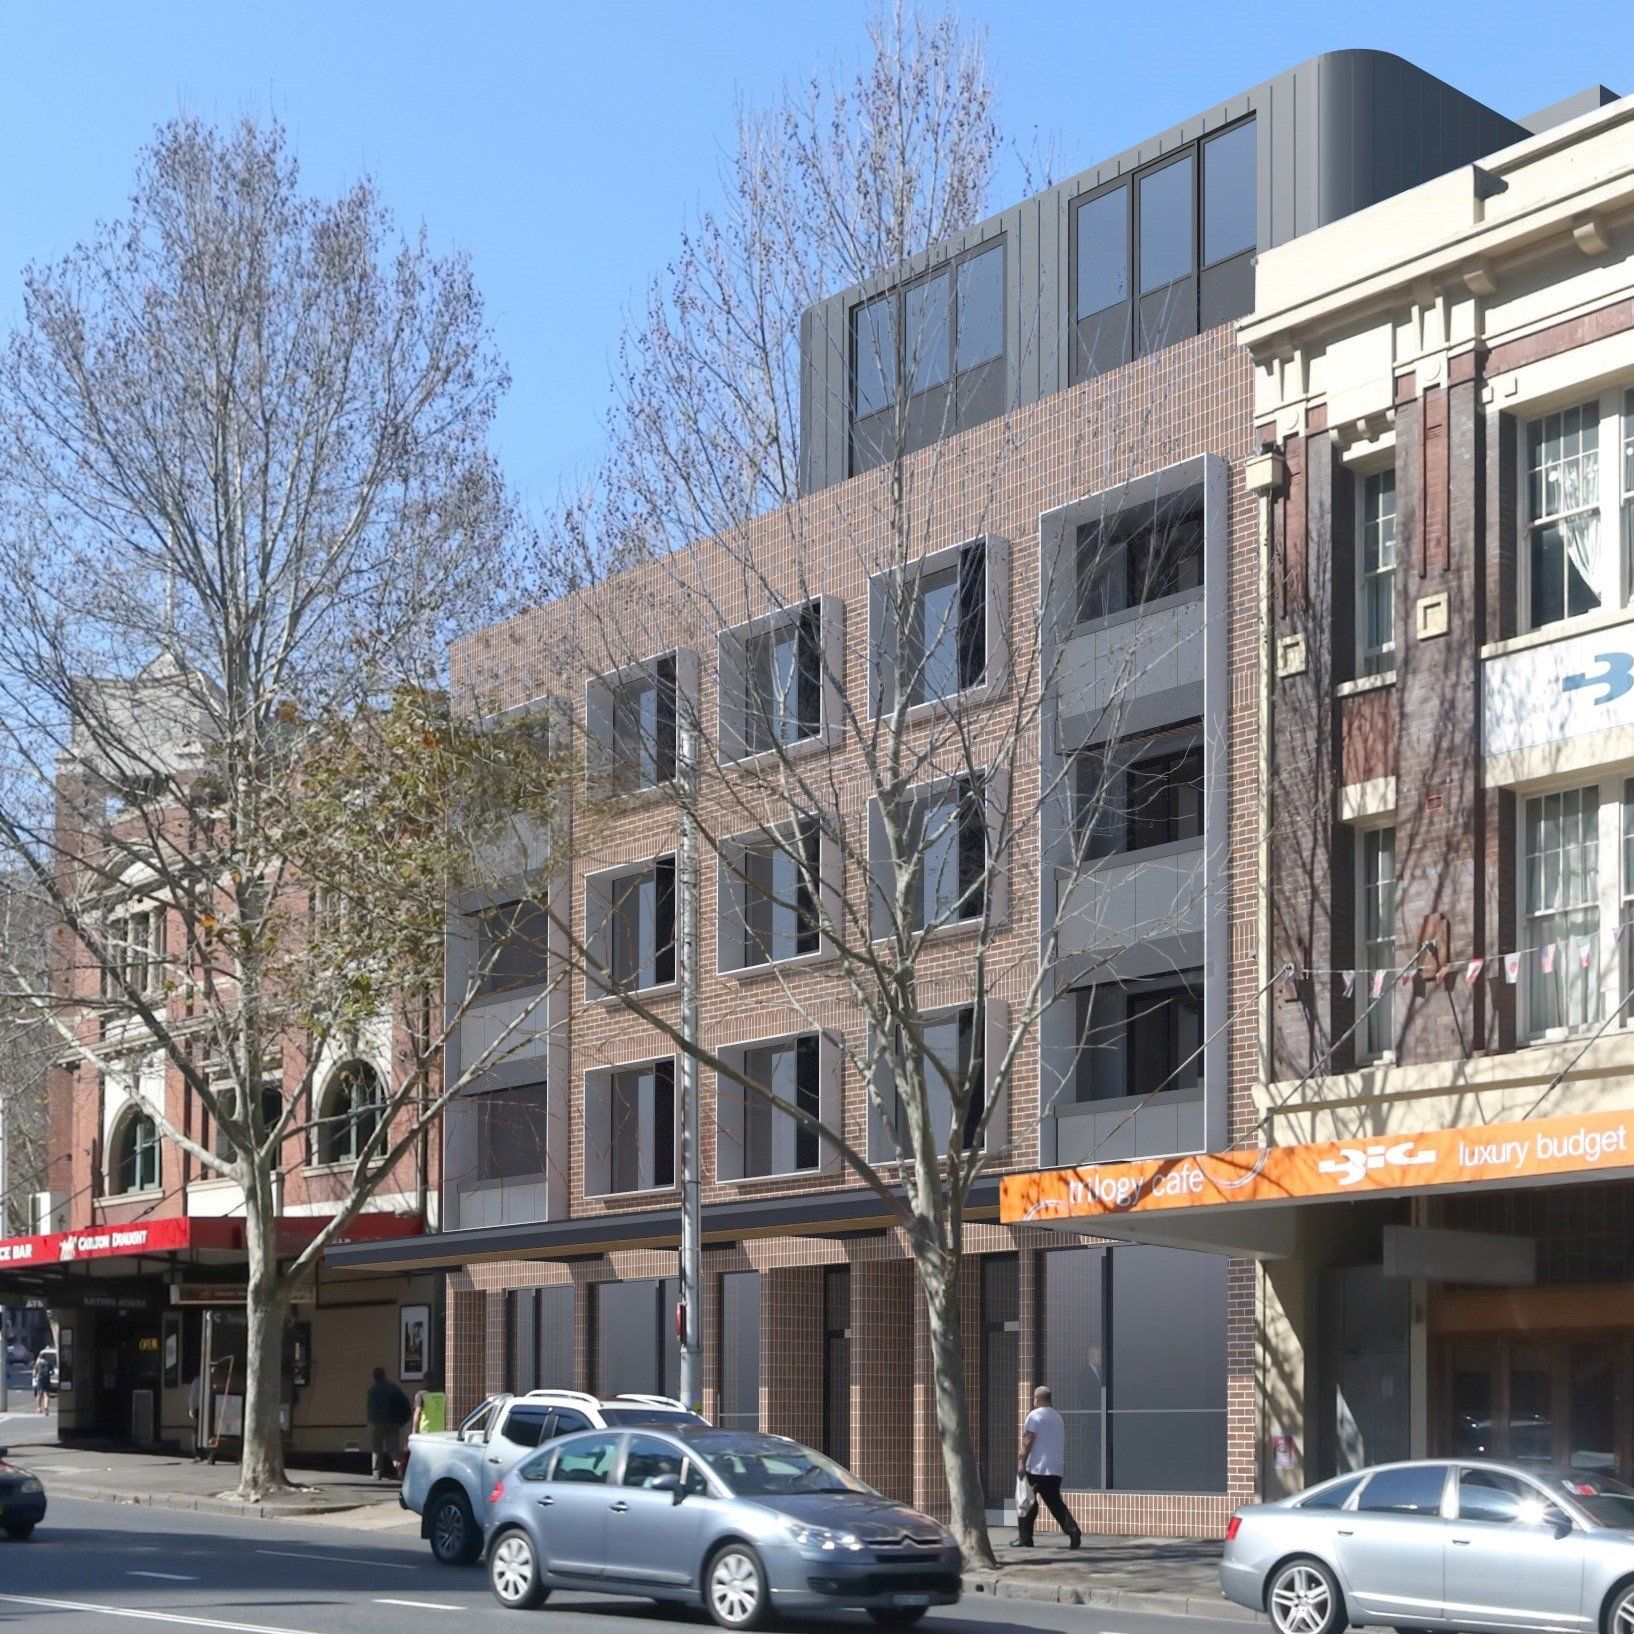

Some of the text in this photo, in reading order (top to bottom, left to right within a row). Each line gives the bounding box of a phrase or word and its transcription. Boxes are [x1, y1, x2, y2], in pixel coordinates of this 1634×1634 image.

[1458, 1140, 1530, 1168] luxury
[1537, 1125, 1627, 1160] budget
[1068, 1163, 1204, 1207] trilogy cafe
[13, 1244, 33, 1259] BAR
